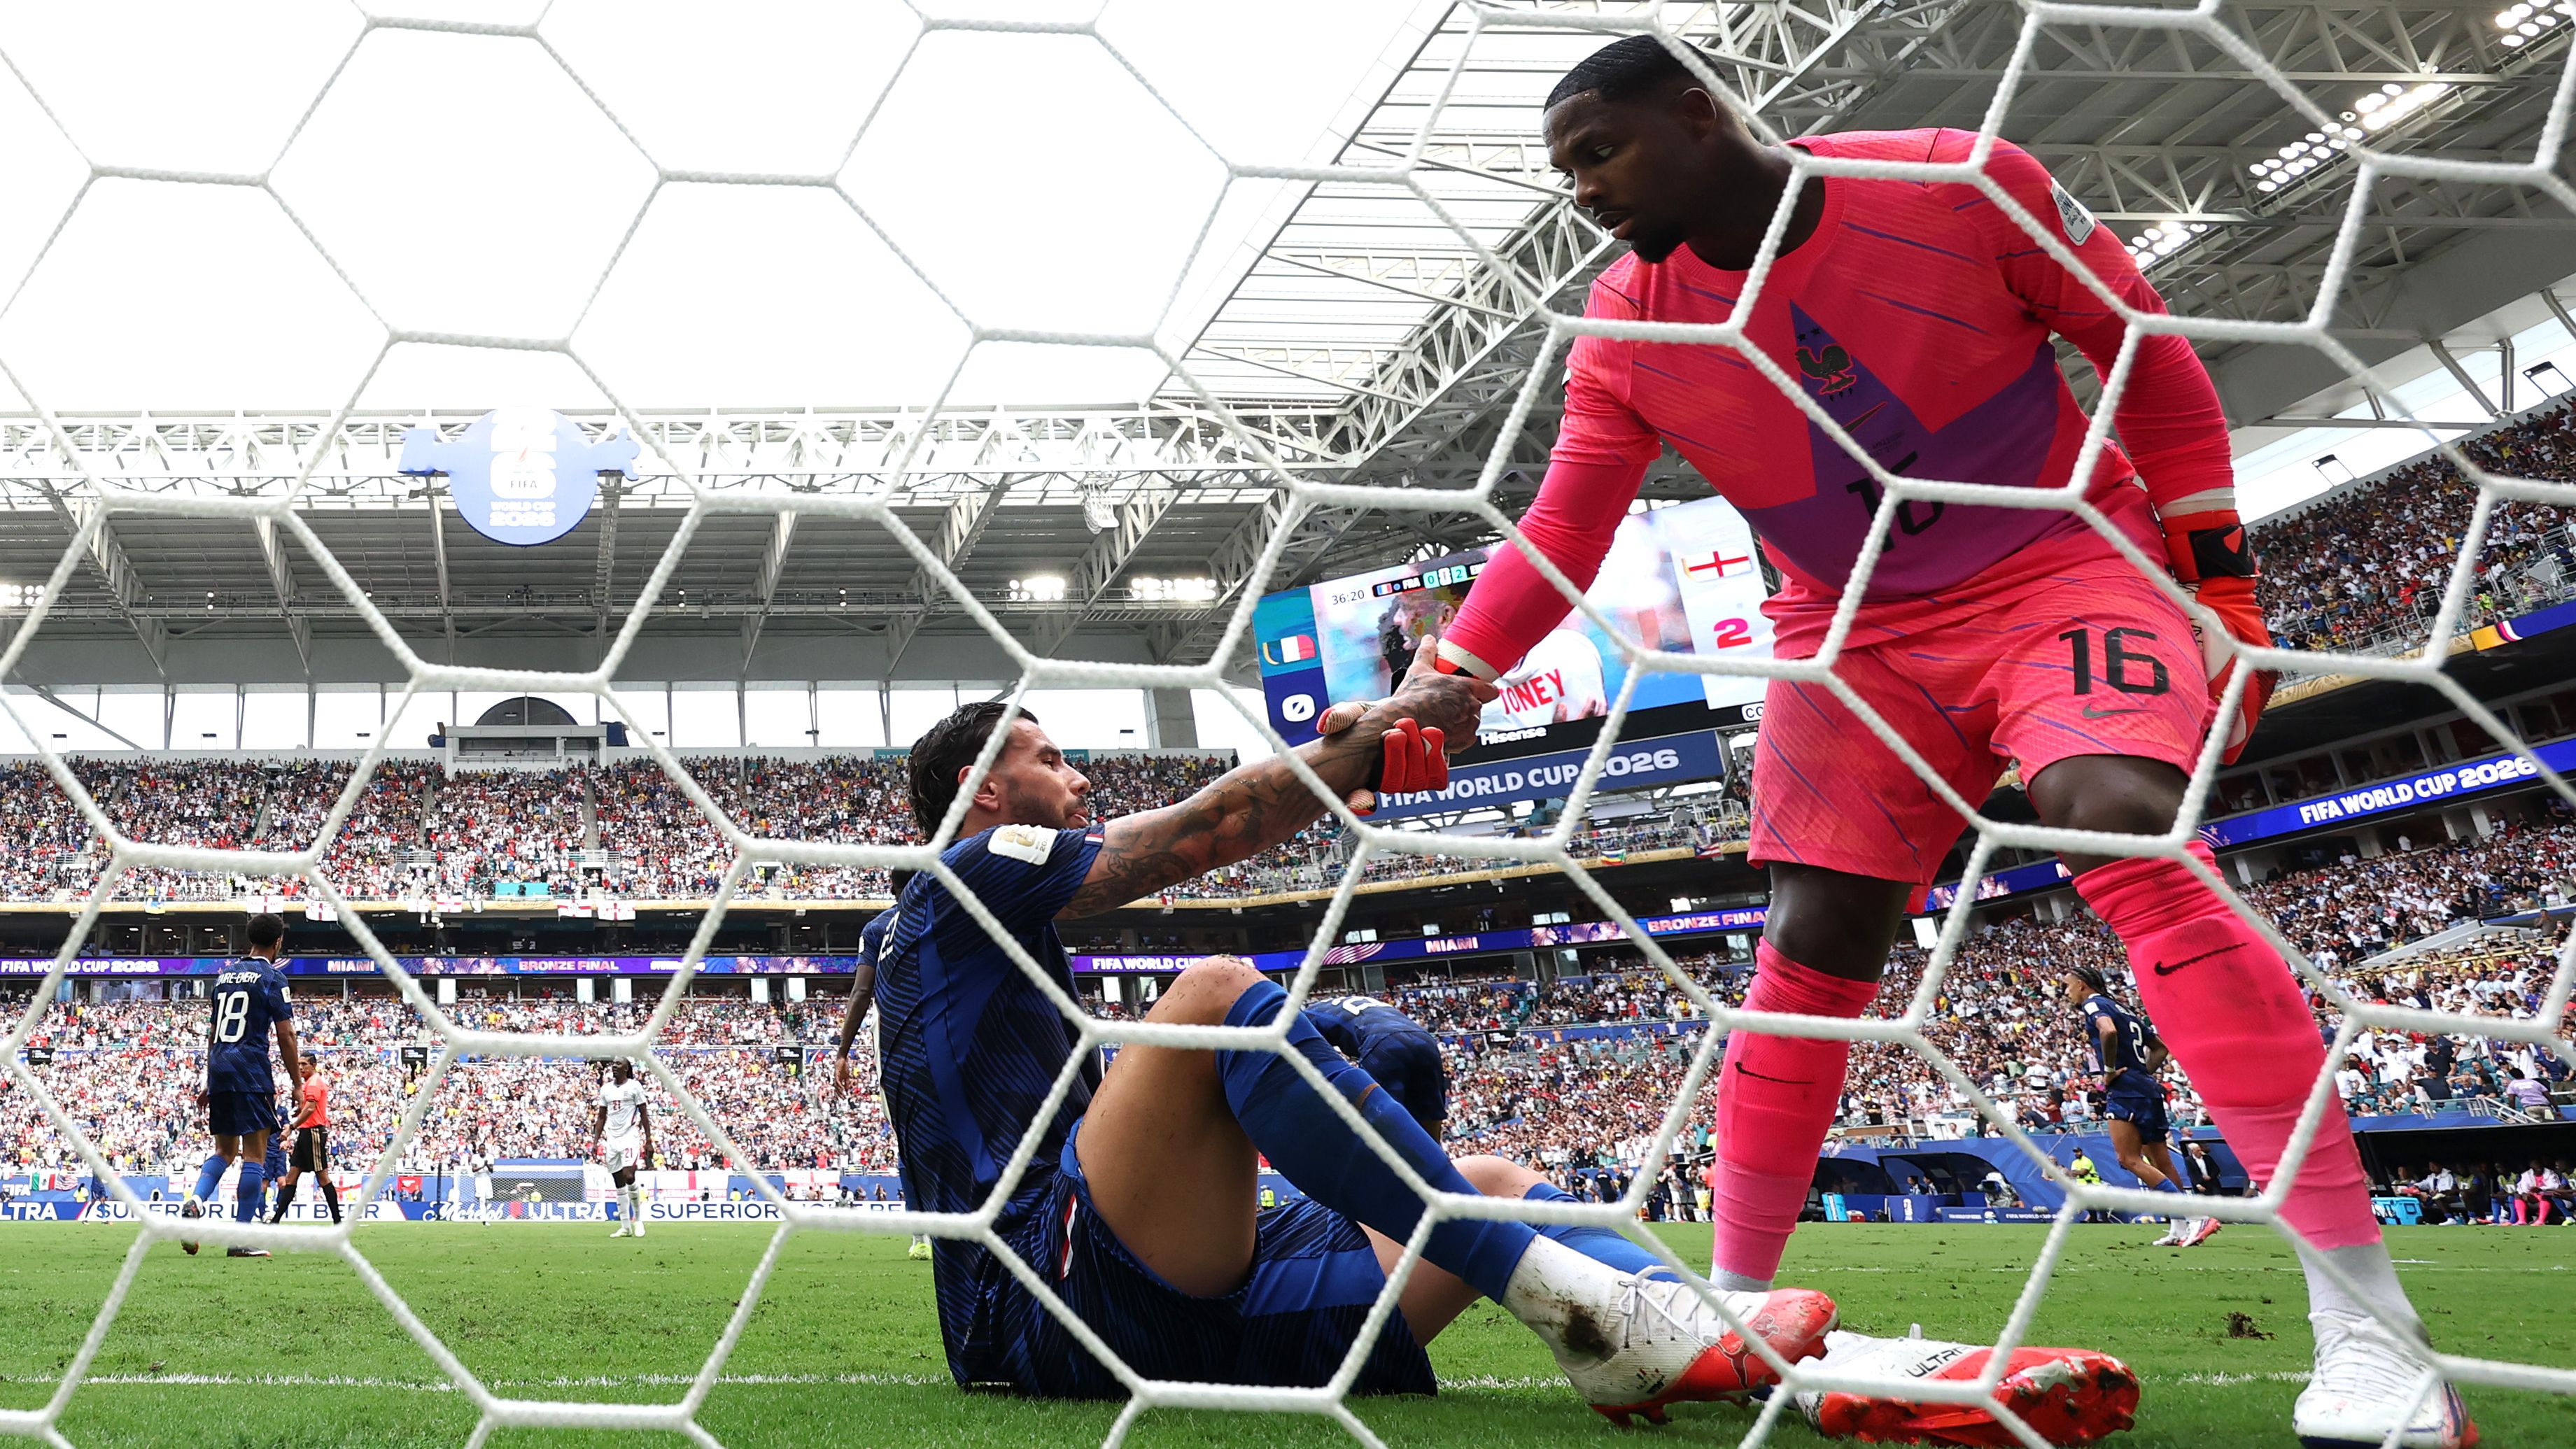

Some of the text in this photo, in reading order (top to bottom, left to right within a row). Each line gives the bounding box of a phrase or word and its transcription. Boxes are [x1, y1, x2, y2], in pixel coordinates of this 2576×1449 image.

[510, 479, 537, 489] FIFA
[491, 501, 556, 511] WORLD CUP
[489, 511, 556, 527] 2026
[1332, 589, 1365, 606] 36:20
[1713, 618, 1752, 649] 2
[2058, 626, 2170, 696] 16
[1499, 668, 1565, 715] TONEY
[1480, 727, 1547, 746] Hisense
[1435, 772, 1524, 800] WORLD
[1527, 763, 1579, 788] CUP
[2299, 756, 2538, 825] FIFA WORLD CUP 2026
[1647, 914, 1721, 933] BRONZE
[1425, 936, 1479, 954] MIAMI
[1, 961, 160, 973] FIFA WOLD CUP 2026
[328, 960, 375, 972] MIAMI
[519, 961, 619, 971] BRONZE FINAL
[1092, 957, 1124, 970] FIFA
[1123, 957, 1175, 970] WORLD
[213, 991, 249, 1044] 18
[624, 1147, 633, 1159] 21
[528, 1202, 607, 1220] ULTRA
[650, 1203, 780, 1220] SUPERIOR
